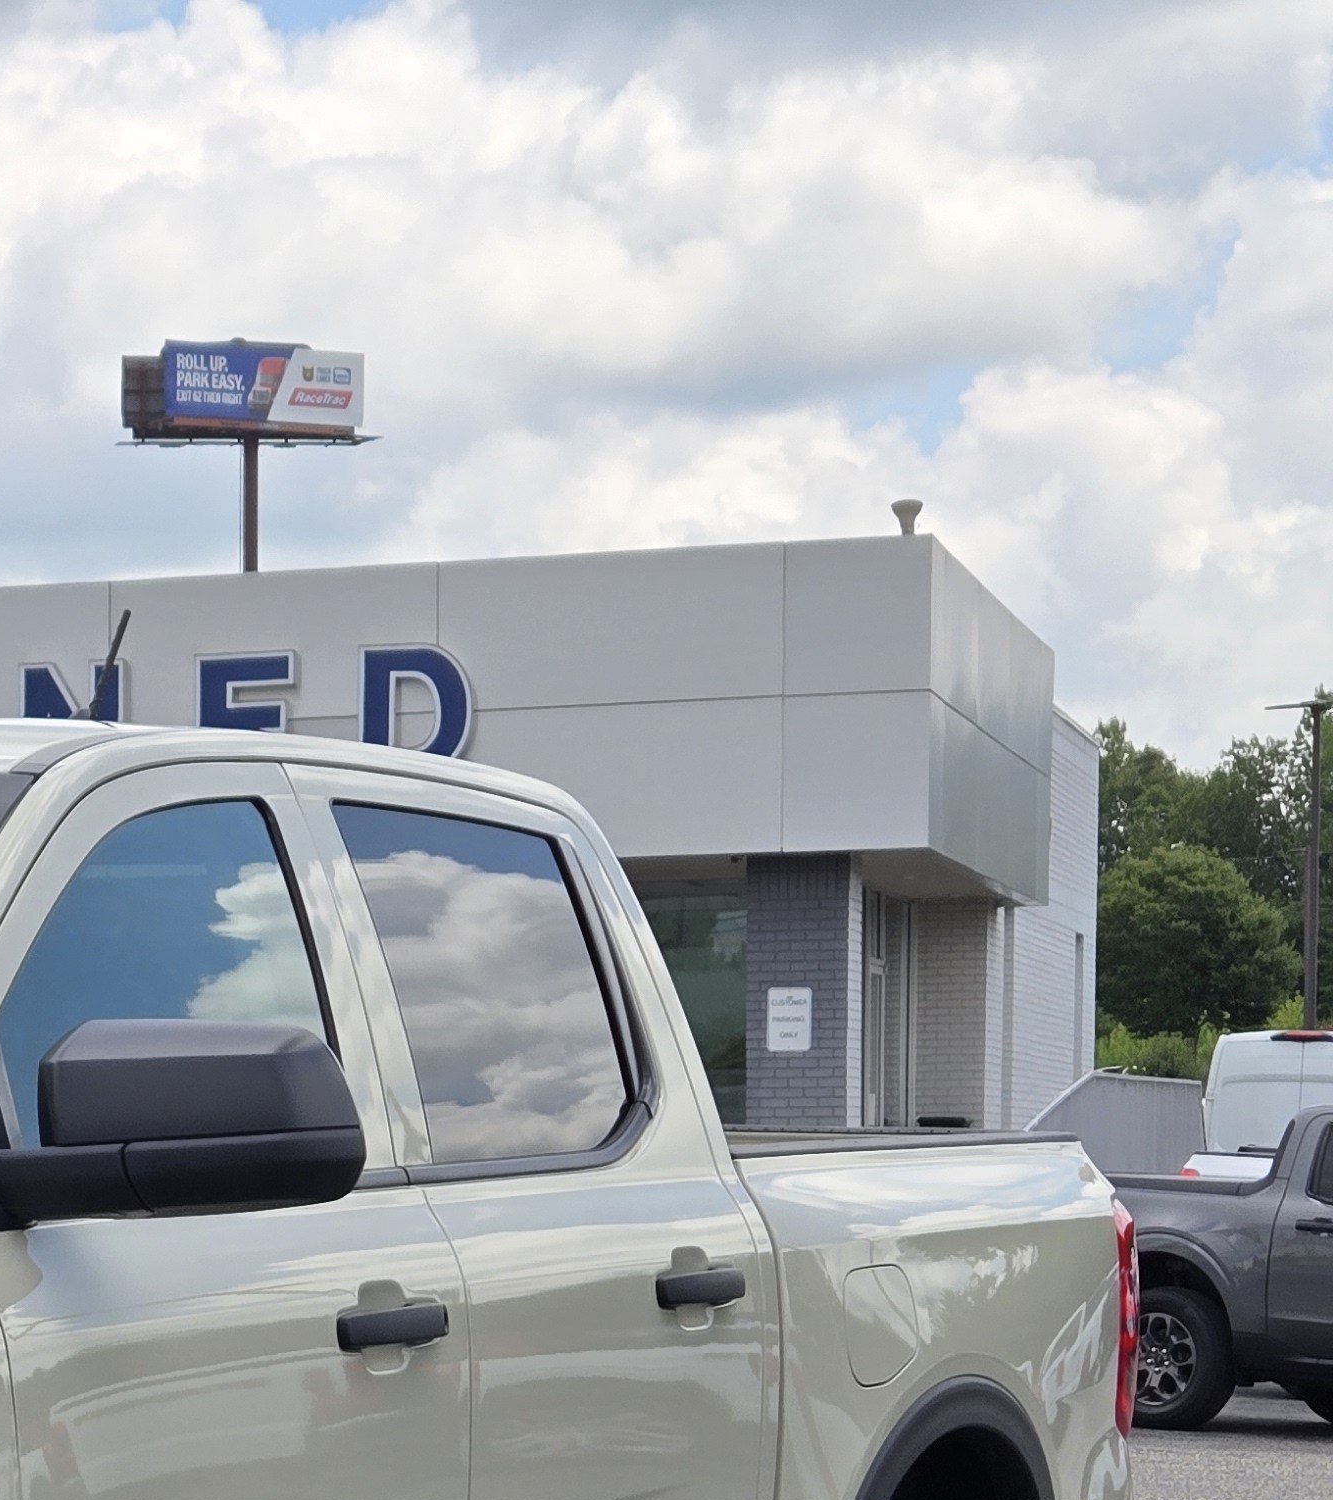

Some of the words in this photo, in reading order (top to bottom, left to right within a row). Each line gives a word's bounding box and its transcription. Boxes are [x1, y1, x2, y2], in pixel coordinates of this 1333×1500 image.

[176, 353, 208, 371] ROLL
[210, 354, 228, 372] UP.
[176, 370, 209, 388] PARK
[212, 373, 245, 391] EASY.
